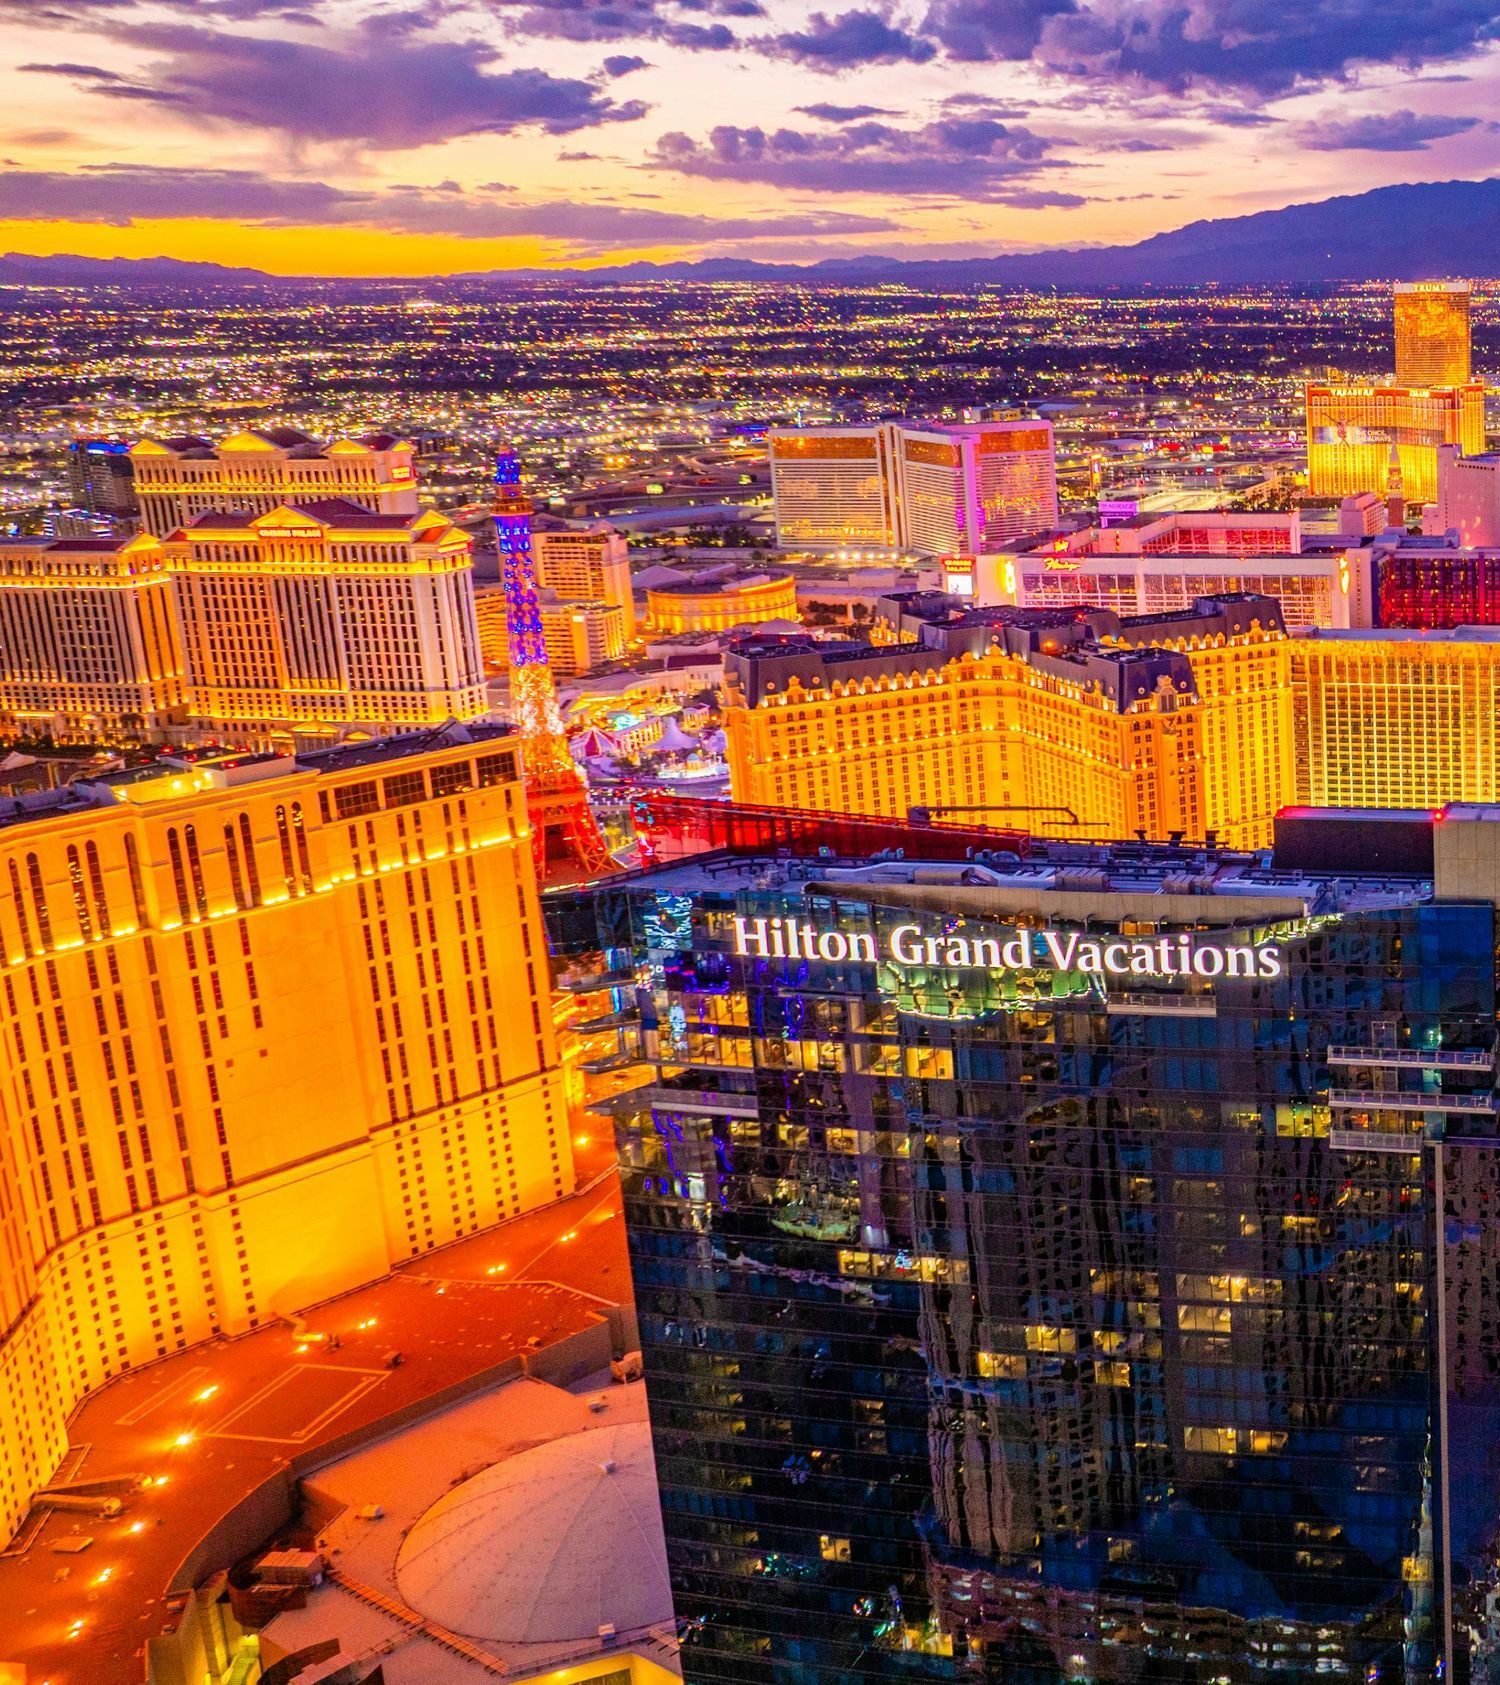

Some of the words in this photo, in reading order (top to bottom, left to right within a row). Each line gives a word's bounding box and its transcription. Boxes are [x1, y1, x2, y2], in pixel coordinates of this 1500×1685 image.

[1412, 283, 1447, 293] TRUMP
[733, 917, 878, 962] Hilton
[889, 925, 1033, 970] Grand
[1043, 932, 1282, 978] Vacations
